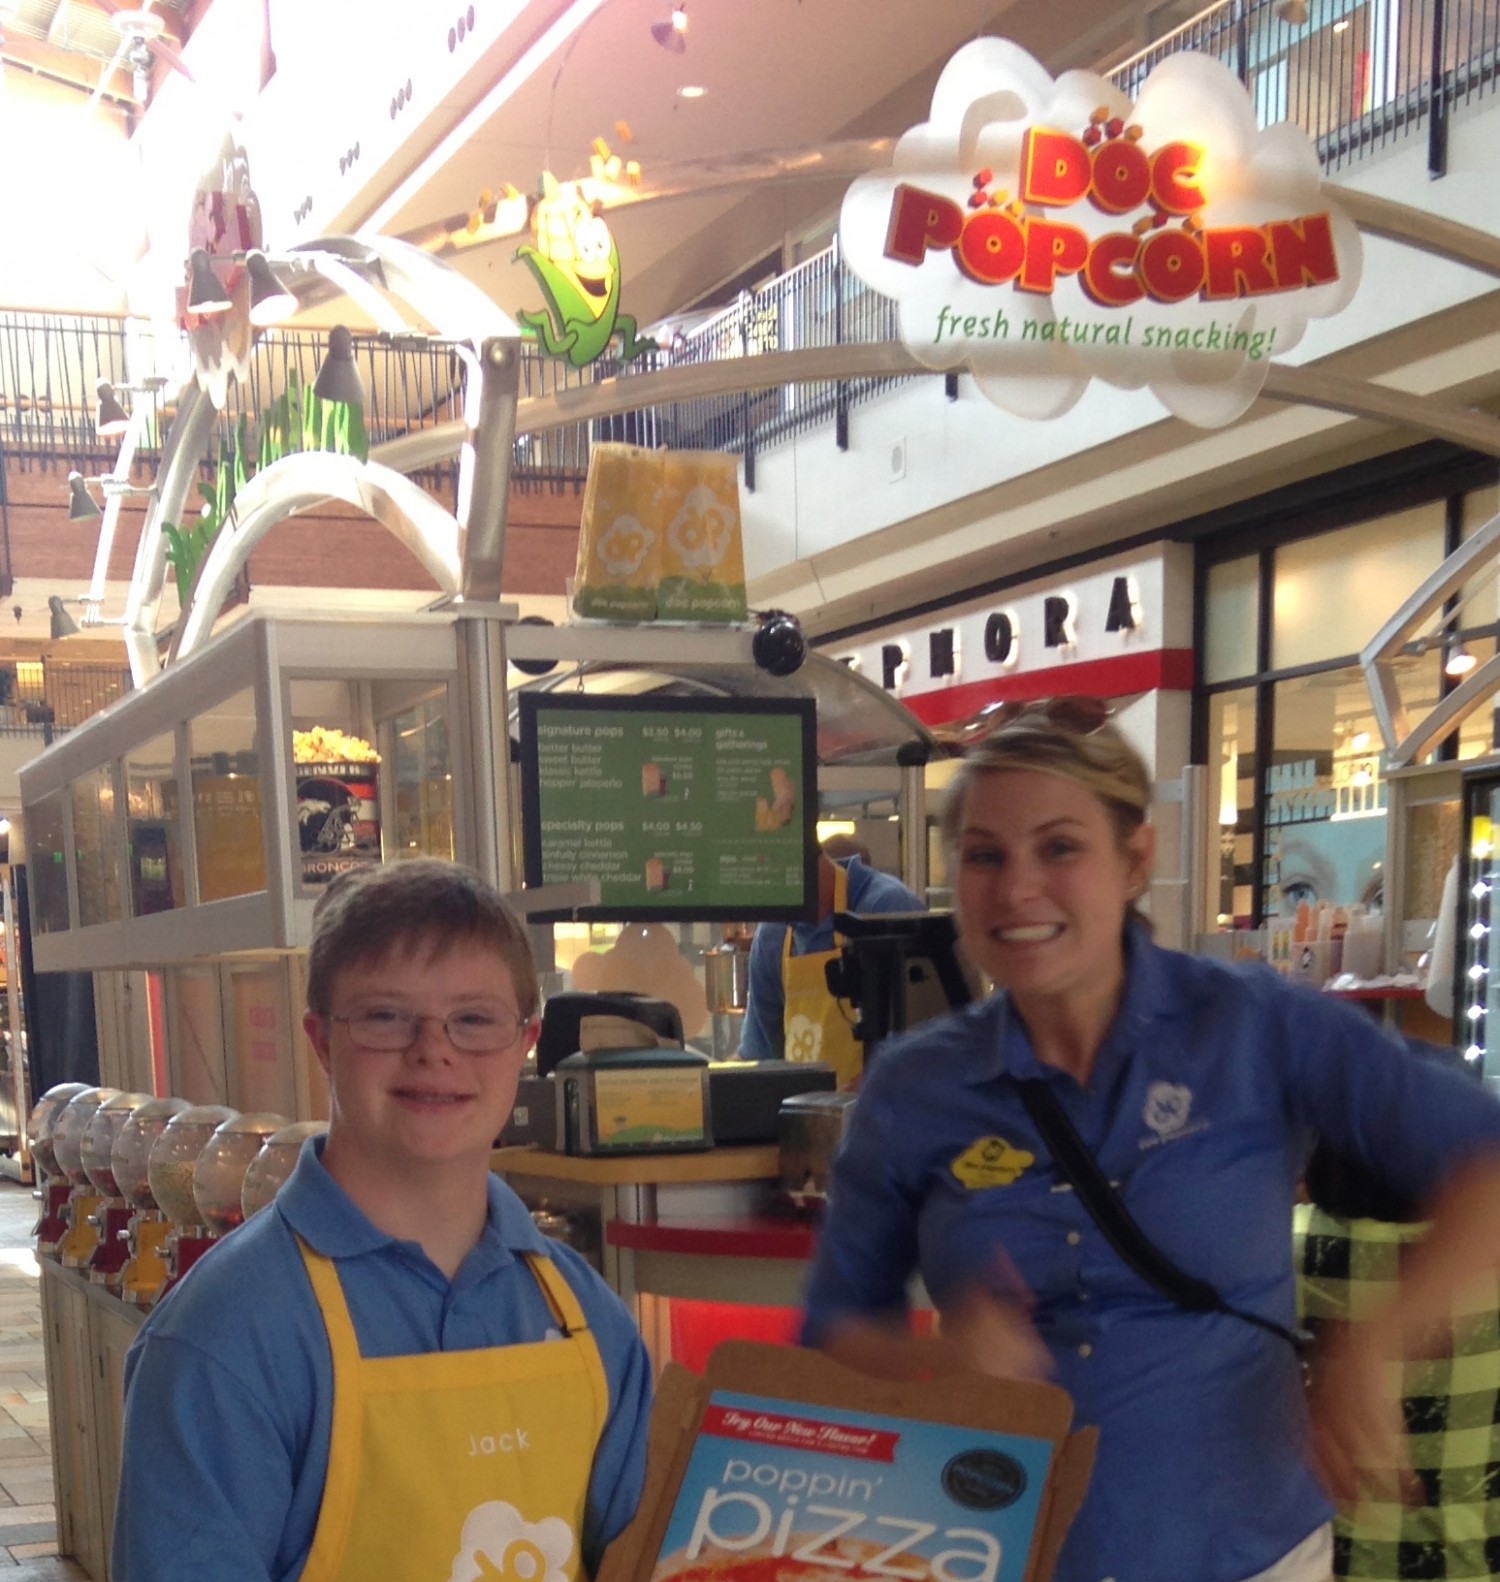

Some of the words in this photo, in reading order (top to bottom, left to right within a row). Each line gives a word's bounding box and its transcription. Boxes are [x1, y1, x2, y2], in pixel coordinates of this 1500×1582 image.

[1019, 126, 1207, 216] DOC
[883, 182, 1339, 308] POPCORN
[933, 306, 1010, 343] fresh
[1021, 317, 1132, 346] natural
[1141, 322, 1277, 361] snacking!
[537, 725, 591, 737] signature
[594, 726, 624, 738] pops
[715, 726, 737, 740] gifts
[571, 743, 602, 753] butter
[571, 755, 602, 764] butter
[541, 820, 592, 832] specialty
[595, 821, 625, 832] pops
[642, 821, 670, 832] $4.00
[722, 1411, 751, 1432] Try
[753, 1416, 783, 1432] Our
[784, 1420, 816, 1438] New
[817, 1425, 877, 1446] Flavor!
[723, 1458, 884, 1501] poppin'
